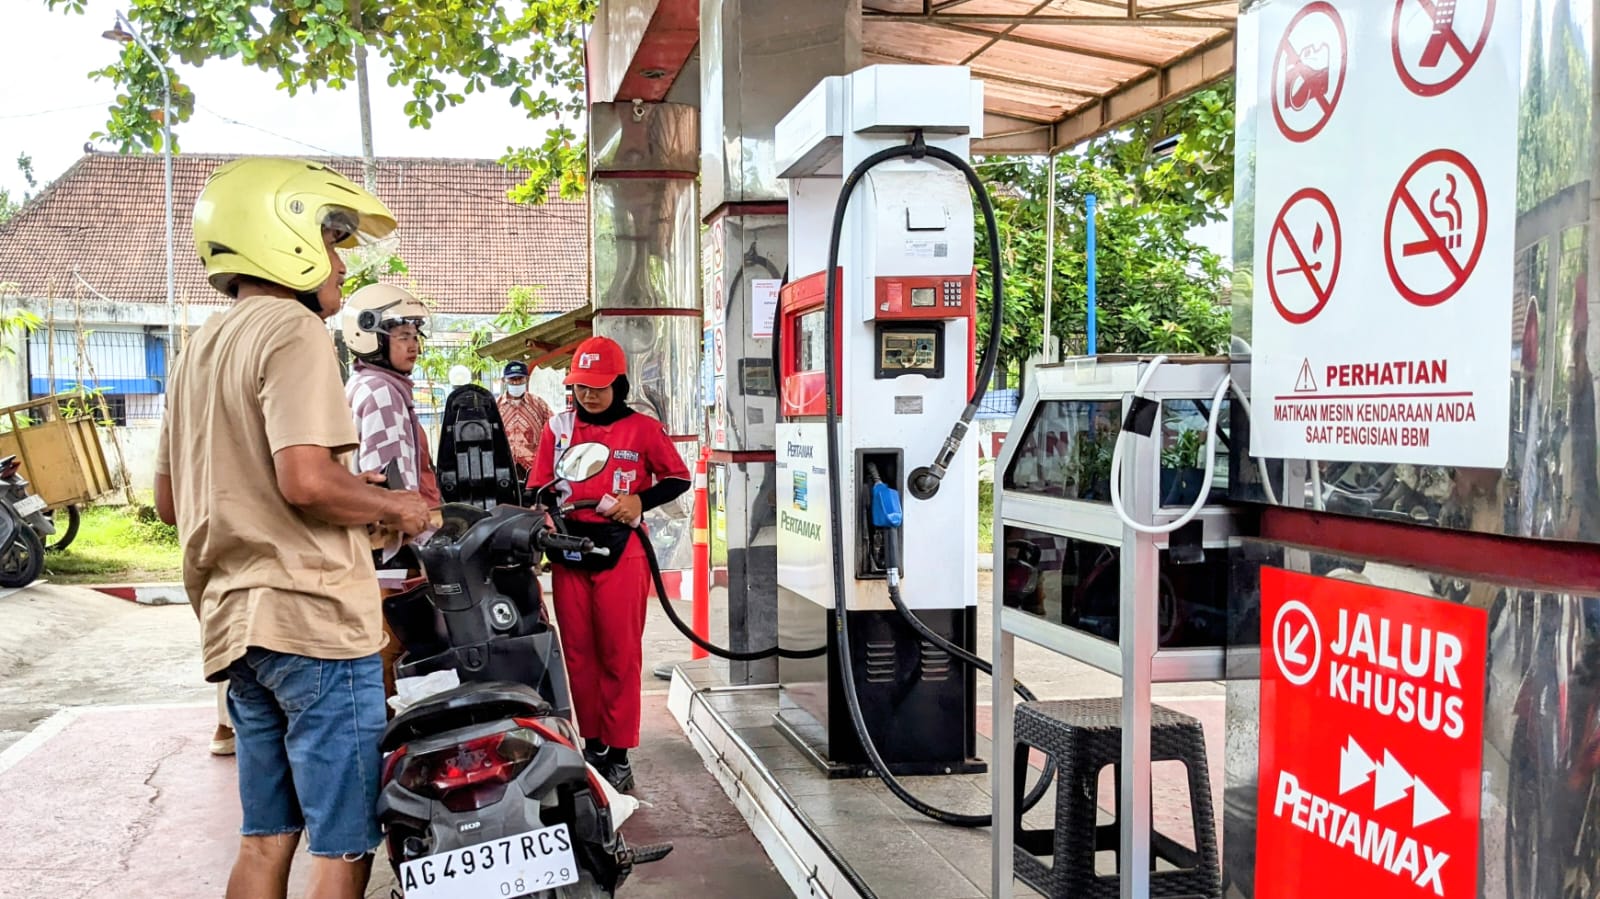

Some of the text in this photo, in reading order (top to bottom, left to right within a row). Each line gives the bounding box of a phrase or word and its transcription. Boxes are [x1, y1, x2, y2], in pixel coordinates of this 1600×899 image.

[1326, 359, 1447, 387] PERHATIAN
[1274, 402, 1476, 422] MATIKAN MESIN KENDARAAN ANDA
[787, 441, 813, 458] PERTAMAX
[1306, 426, 1430, 447] SAAT PENGISIAN BBM
[781, 510, 821, 541] PERTAMAX
[1330, 608, 1463, 689] JALUR
[1329, 661, 1465, 739] KHUSUS
[1273, 770, 1450, 897] PERTAMAX
[405, 828, 570, 892] AG 4937 RCS
